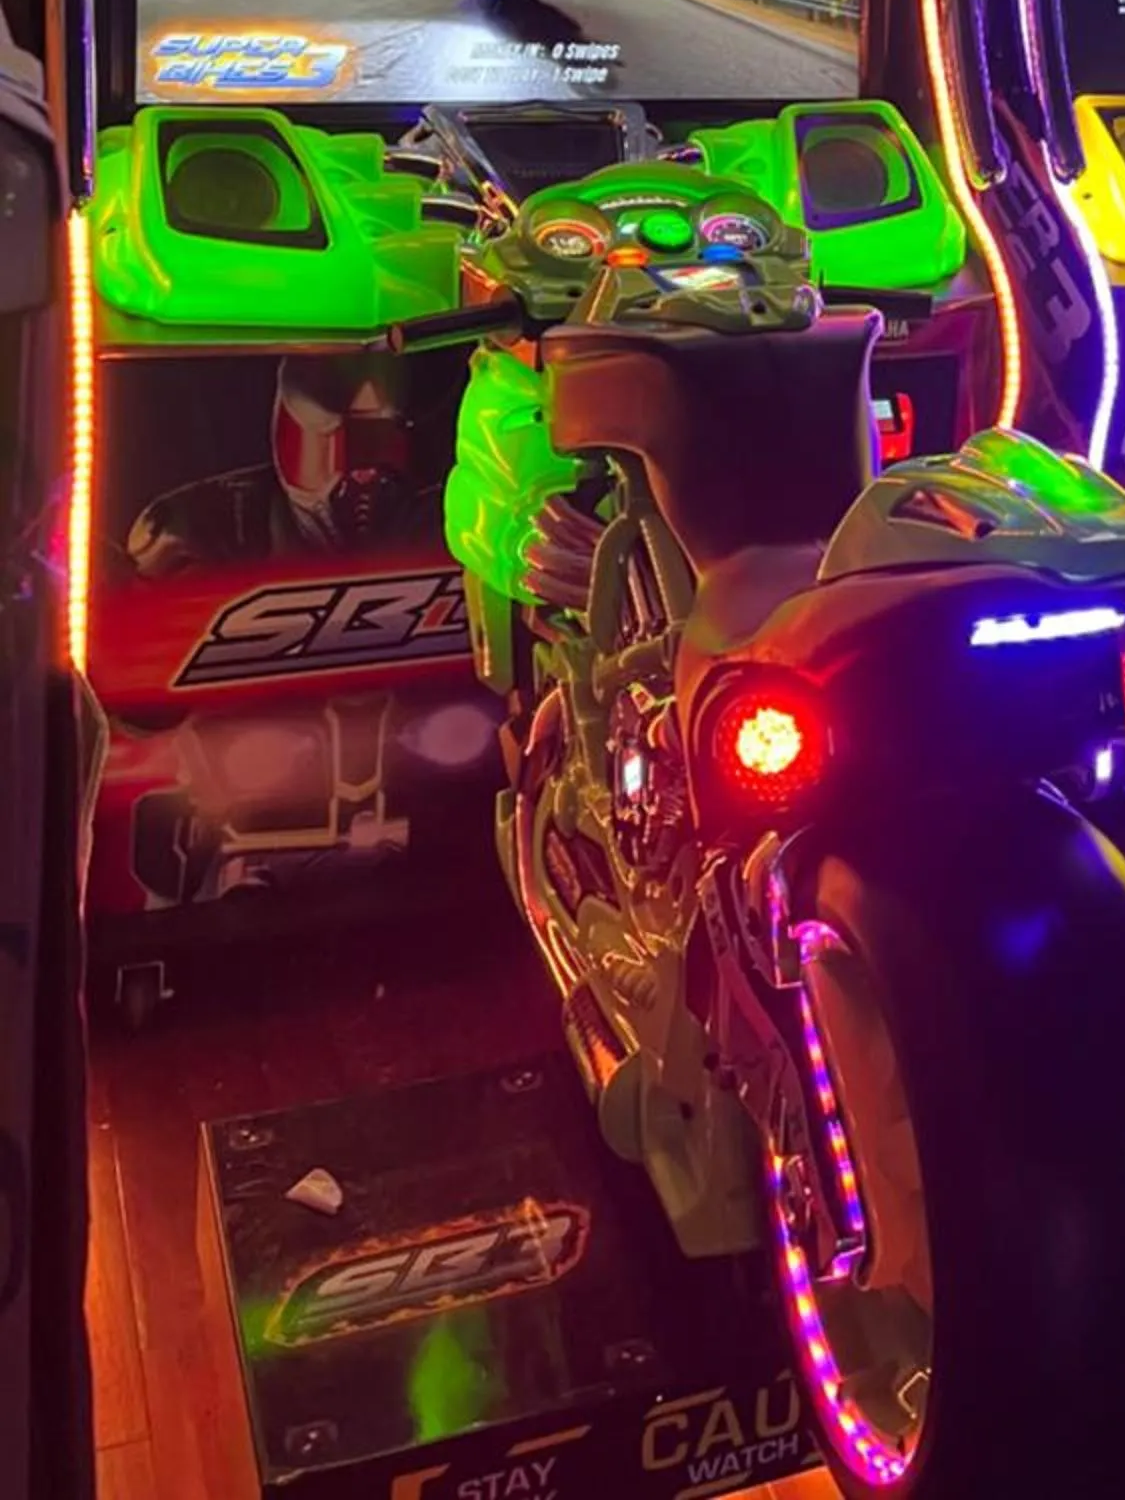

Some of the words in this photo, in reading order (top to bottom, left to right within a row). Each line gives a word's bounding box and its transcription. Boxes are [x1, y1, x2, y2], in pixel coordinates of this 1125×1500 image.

[152, 33, 308, 58] SUPER
[178, 570, 470, 682] SB
[457, 1457, 556, 1500] STAY
[688, 1432, 799, 1484] WATCH
